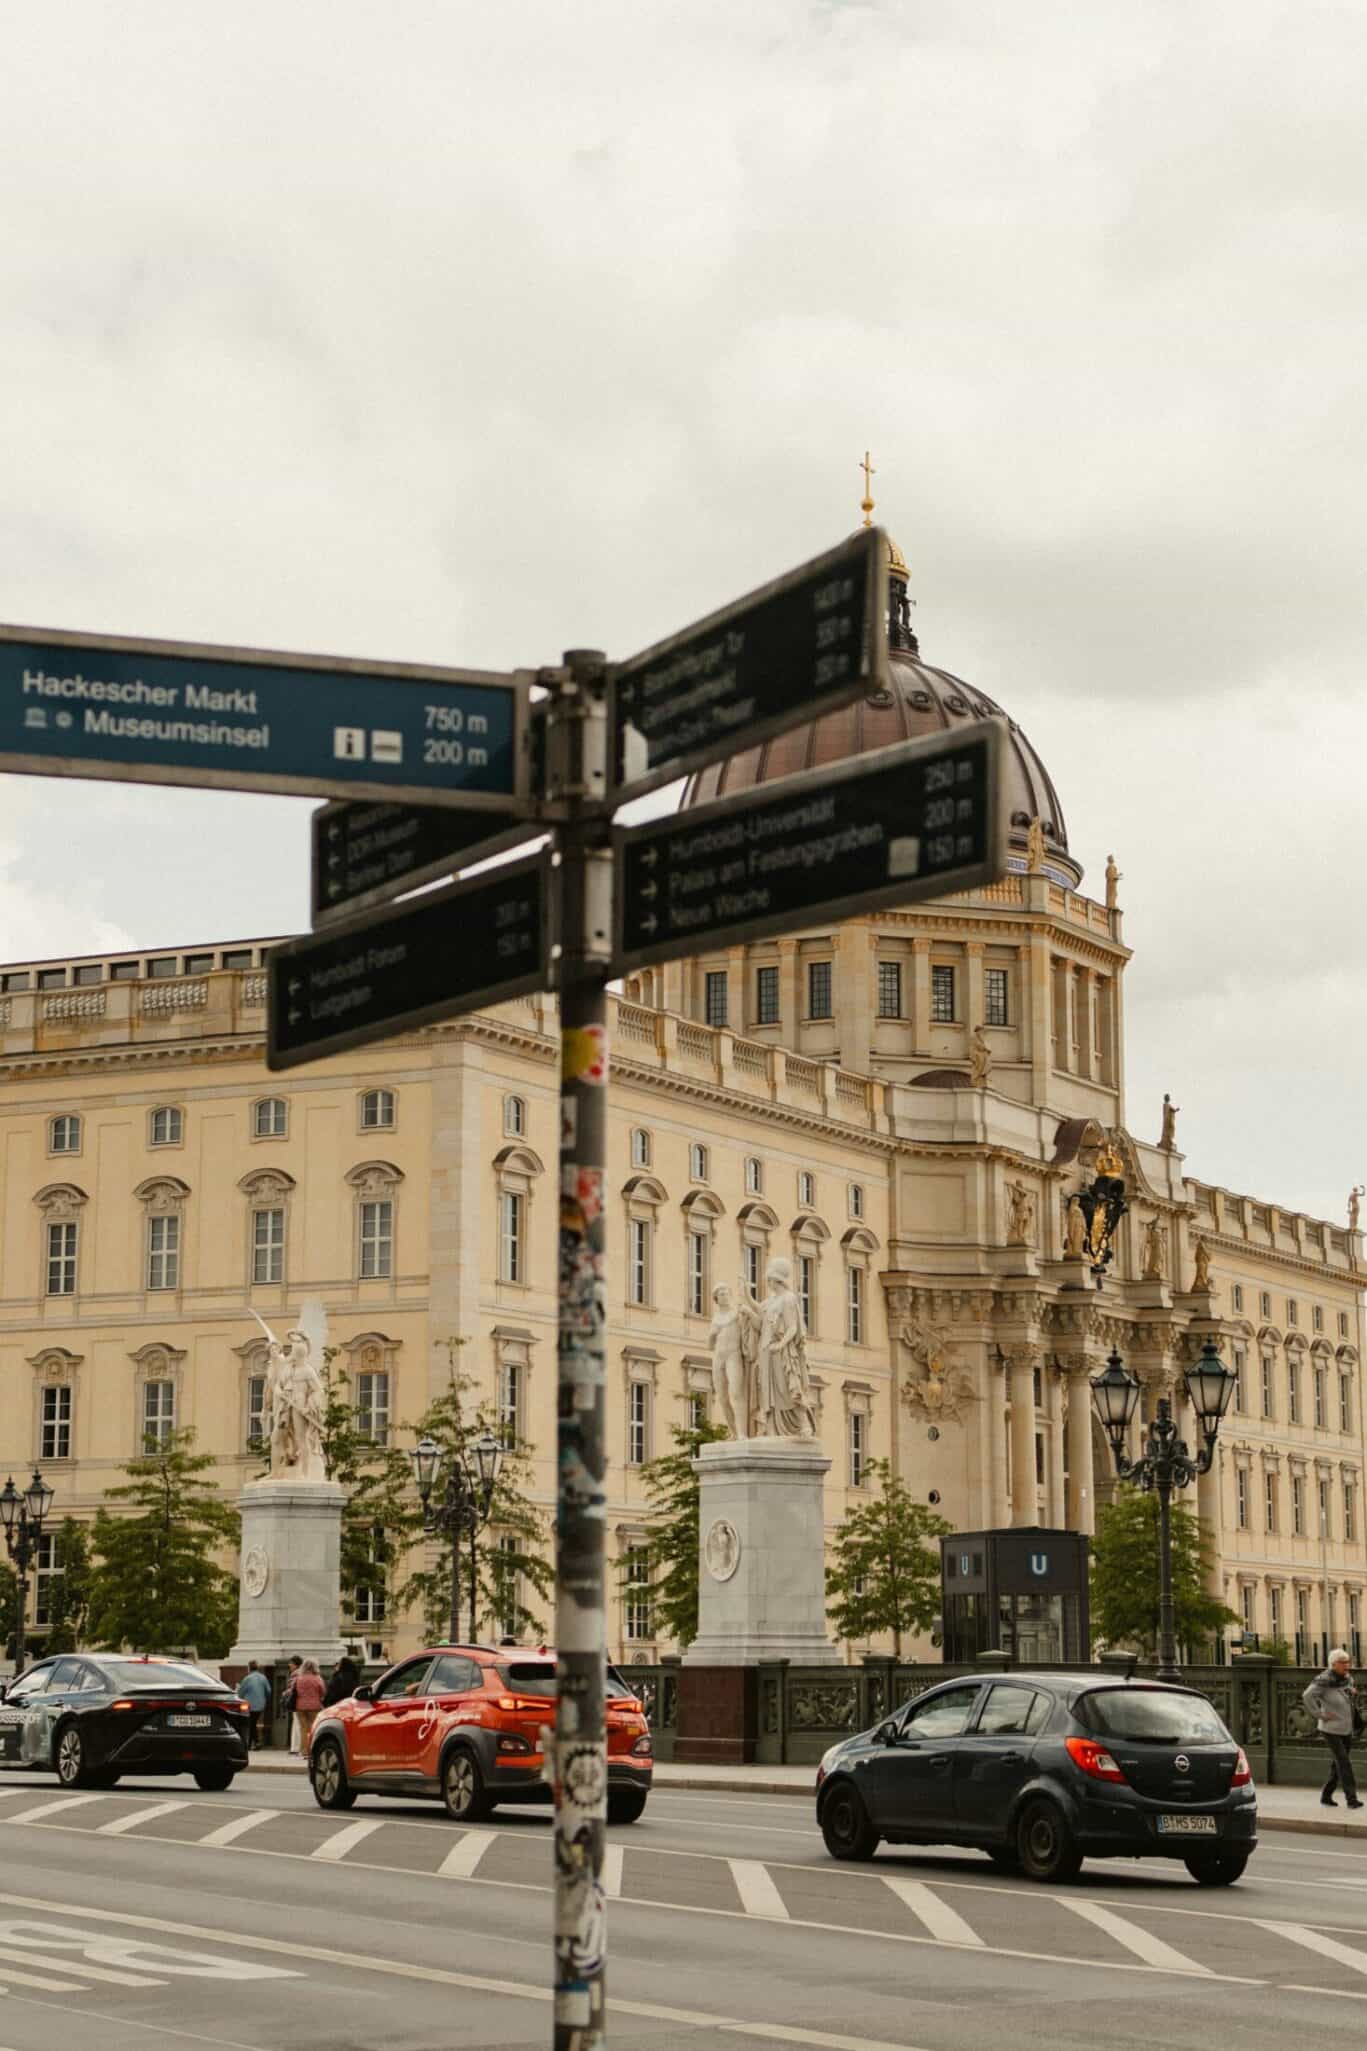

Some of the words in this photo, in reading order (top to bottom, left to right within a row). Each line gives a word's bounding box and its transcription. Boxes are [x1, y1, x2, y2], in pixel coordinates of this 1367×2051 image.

[22, 669, 178, 708] Hackescher
[185, 684, 258, 714] Markt
[84, 708, 270, 748] Museumsinsel
[423, 704, 464, 733] 750
[467, 714, 488, 735] m
[423, 737, 464, 766] 200
[467, 746, 488, 771] m
[1031, 1554, 1048, 1576] U
